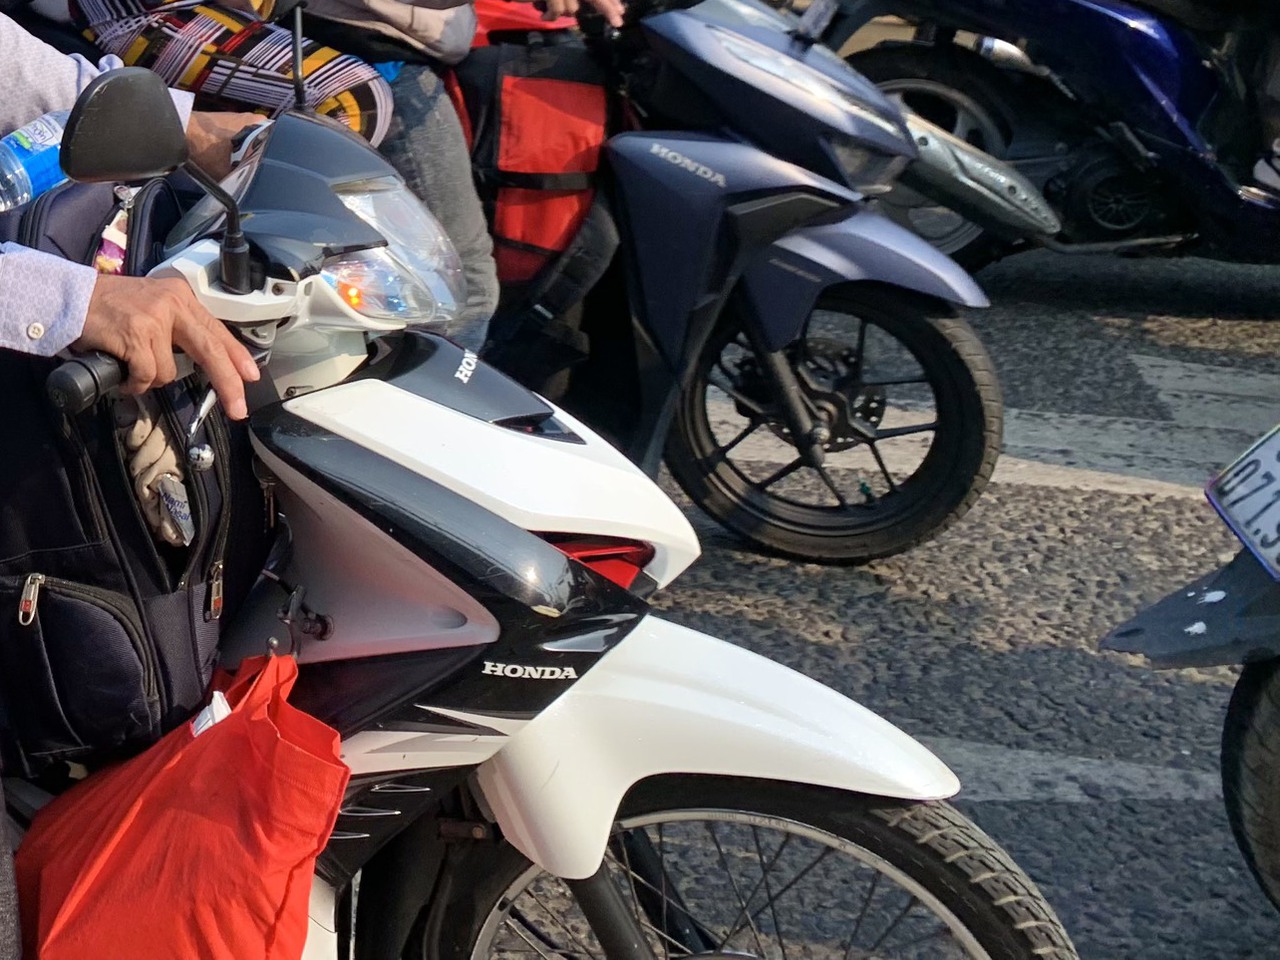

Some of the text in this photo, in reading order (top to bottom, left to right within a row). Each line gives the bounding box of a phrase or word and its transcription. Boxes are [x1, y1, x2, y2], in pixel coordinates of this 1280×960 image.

[650, 142, 727, 188] HONDA
[454, 349, 478, 384] HON
[481, 661, 578, 680] HONDA
